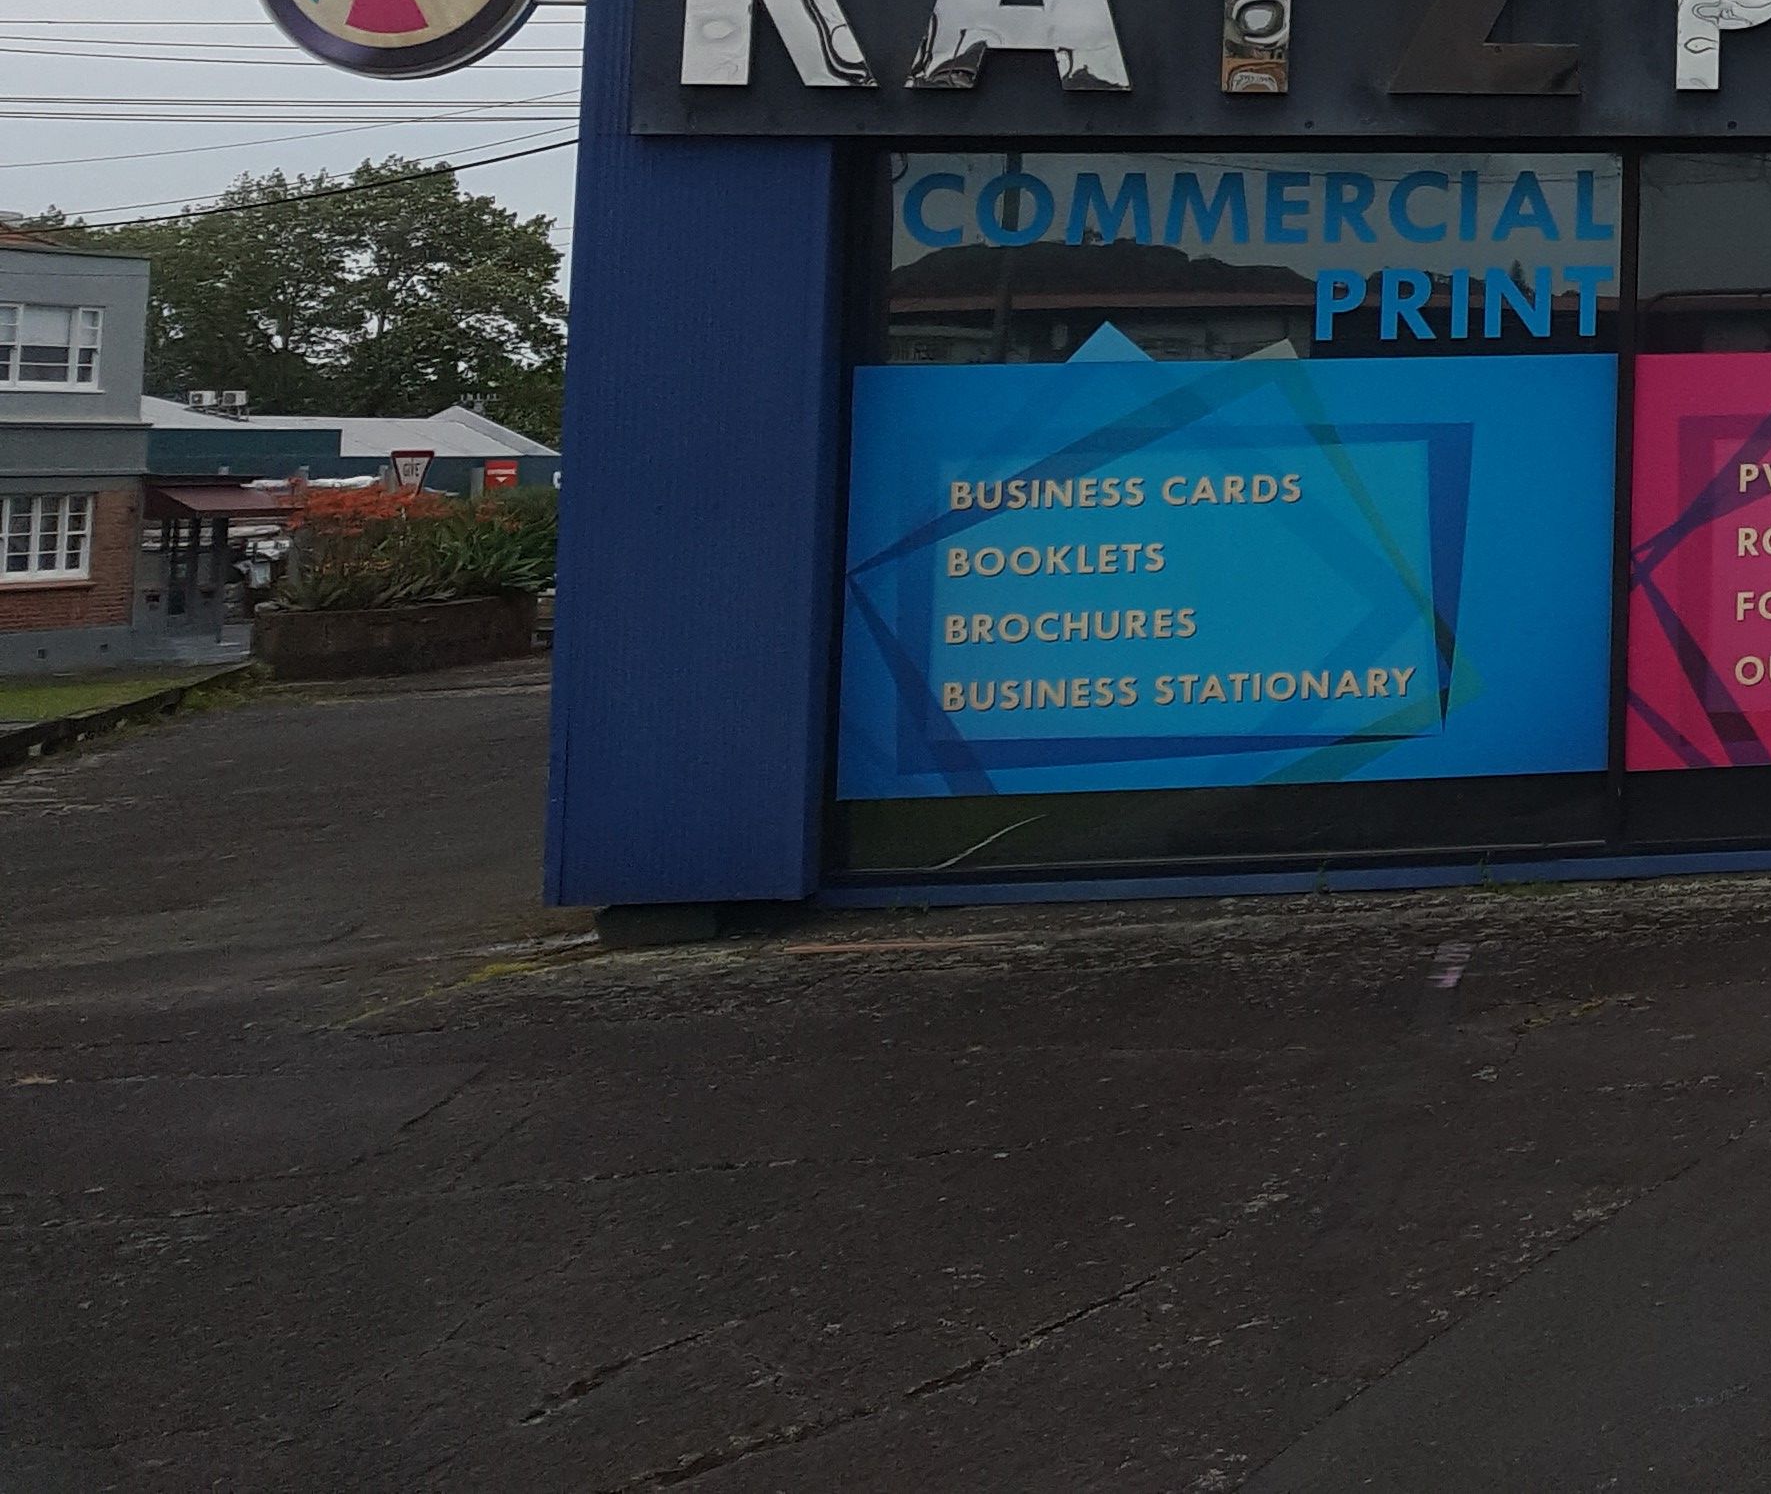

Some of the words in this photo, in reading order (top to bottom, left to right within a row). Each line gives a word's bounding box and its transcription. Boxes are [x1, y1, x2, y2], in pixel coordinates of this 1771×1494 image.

[901, 168, 1615, 247] COMMERCIAL
[1314, 265, 1614, 342] PRINT
[949, 477, 1146, 512] BUSINESS
[1161, 473, 1303, 505] CARDS
[945, 543, 1166, 578] BOOKLETS
[944, 609, 1198, 645] BROCHURES
[941, 677, 1139, 712] BUSINESS
[1153, 666, 1417, 706] STATIONARY
